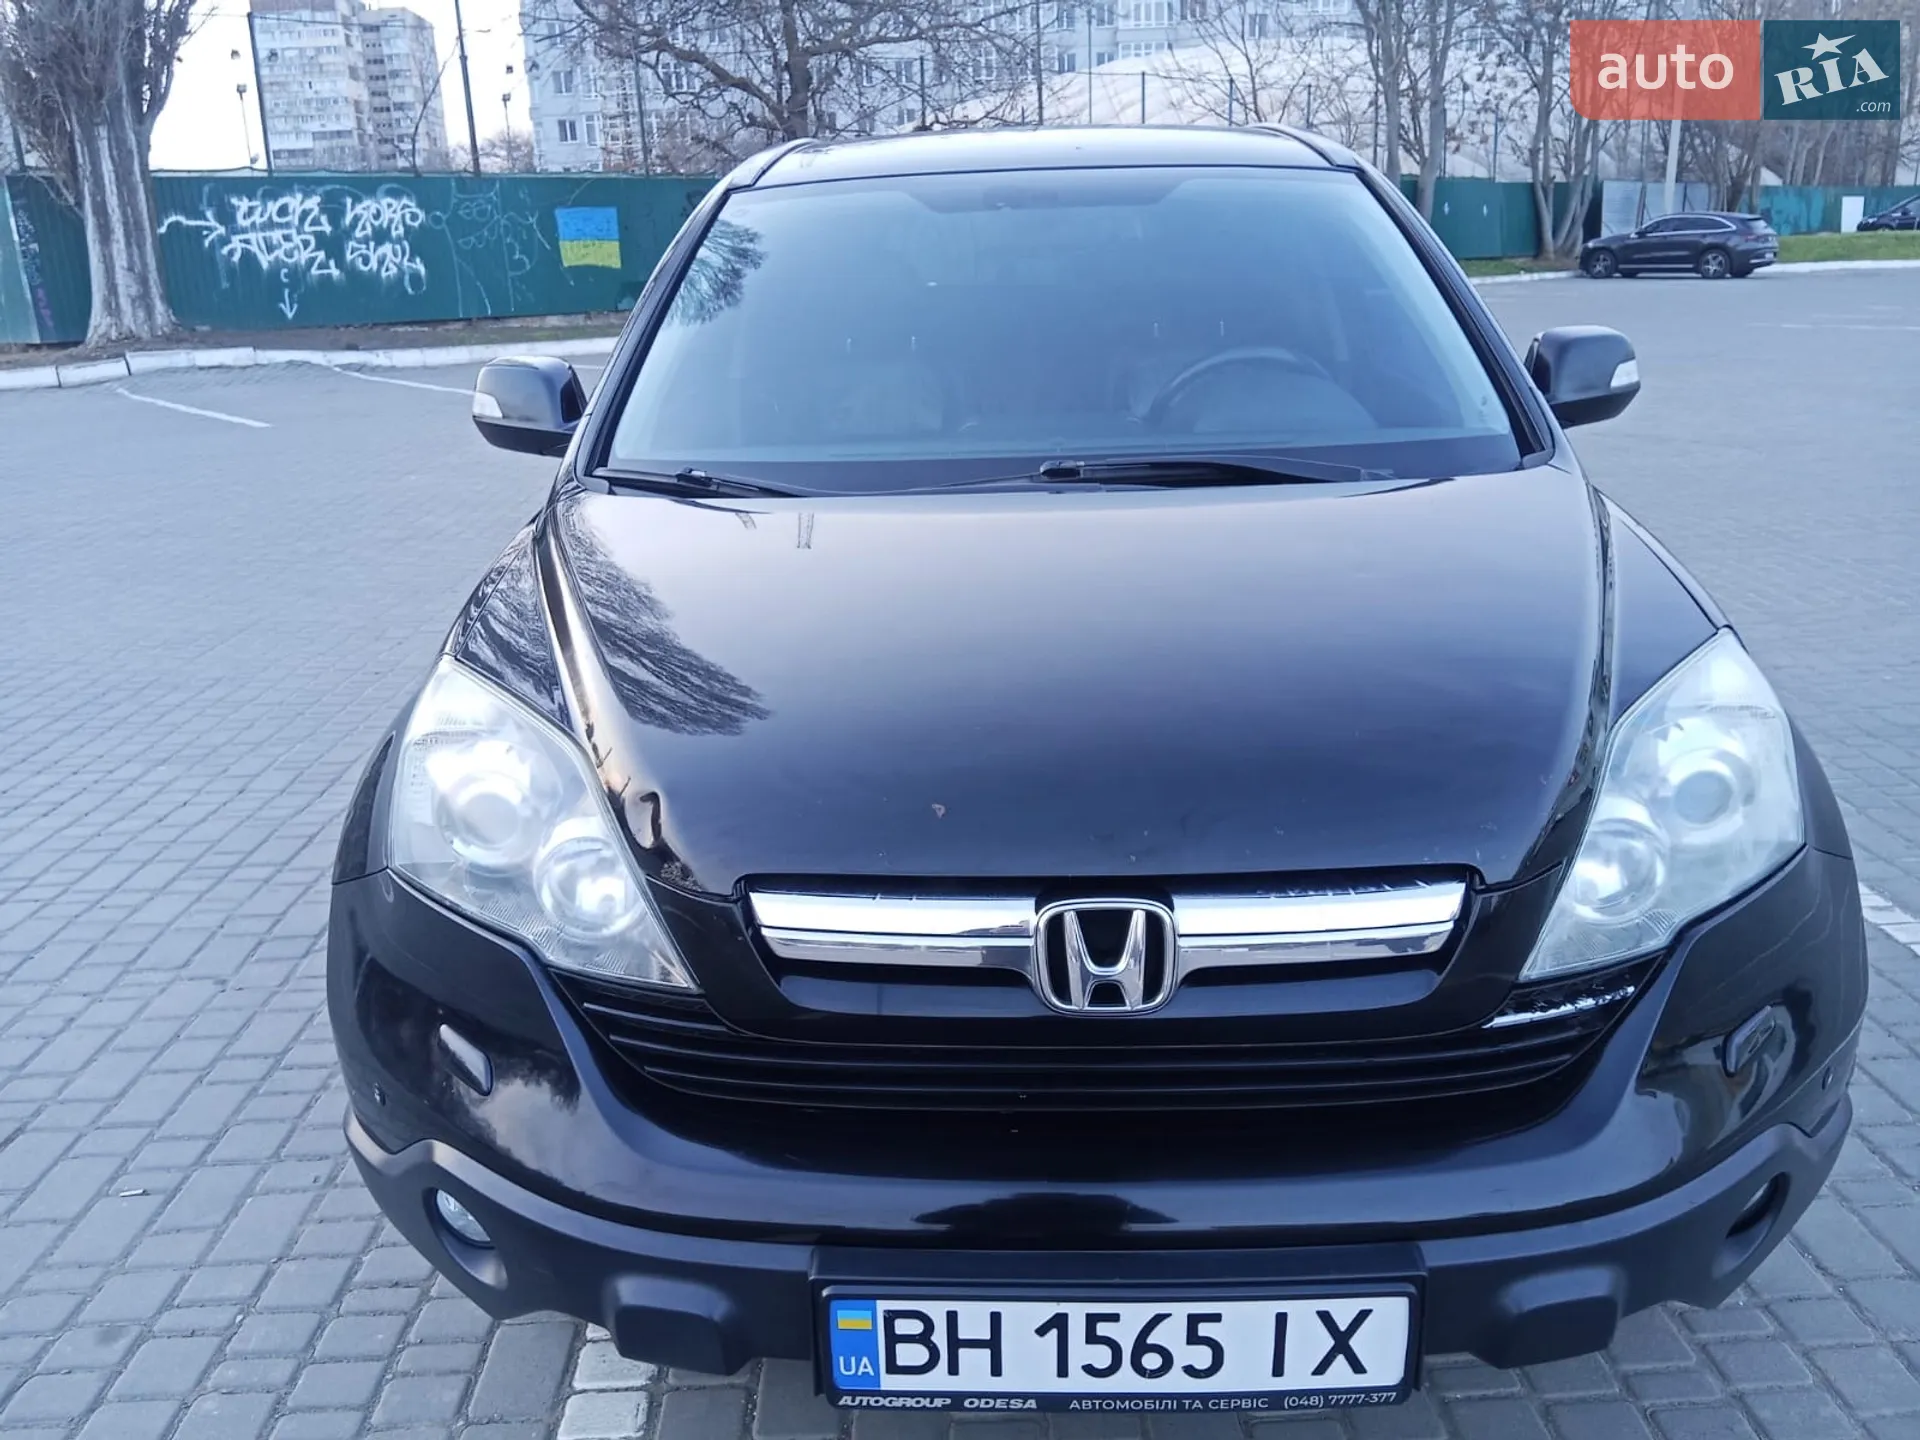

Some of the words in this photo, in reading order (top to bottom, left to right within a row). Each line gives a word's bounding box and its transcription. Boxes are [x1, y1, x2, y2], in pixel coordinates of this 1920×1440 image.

[883, 1309, 1002, 1377] BH
[1034, 1312, 1225, 1379] 1565
[1271, 1309, 1374, 1377] IX
[839, 1356, 875, 1376] UA
[838, 1395, 952, 1408] AUTOGROUP
[963, 1398, 1037, 1409] ODESA
[1069, 1399, 1178, 1411] АВТОМОБІЛІ
[1182, 1399, 1204, 1410] ТА
[1208, 1397, 1269, 1410] СЕРВІС
[1283, 1395, 1325, 1409] (048)
[1328, 1392, 1397, 1405] 7777-377
